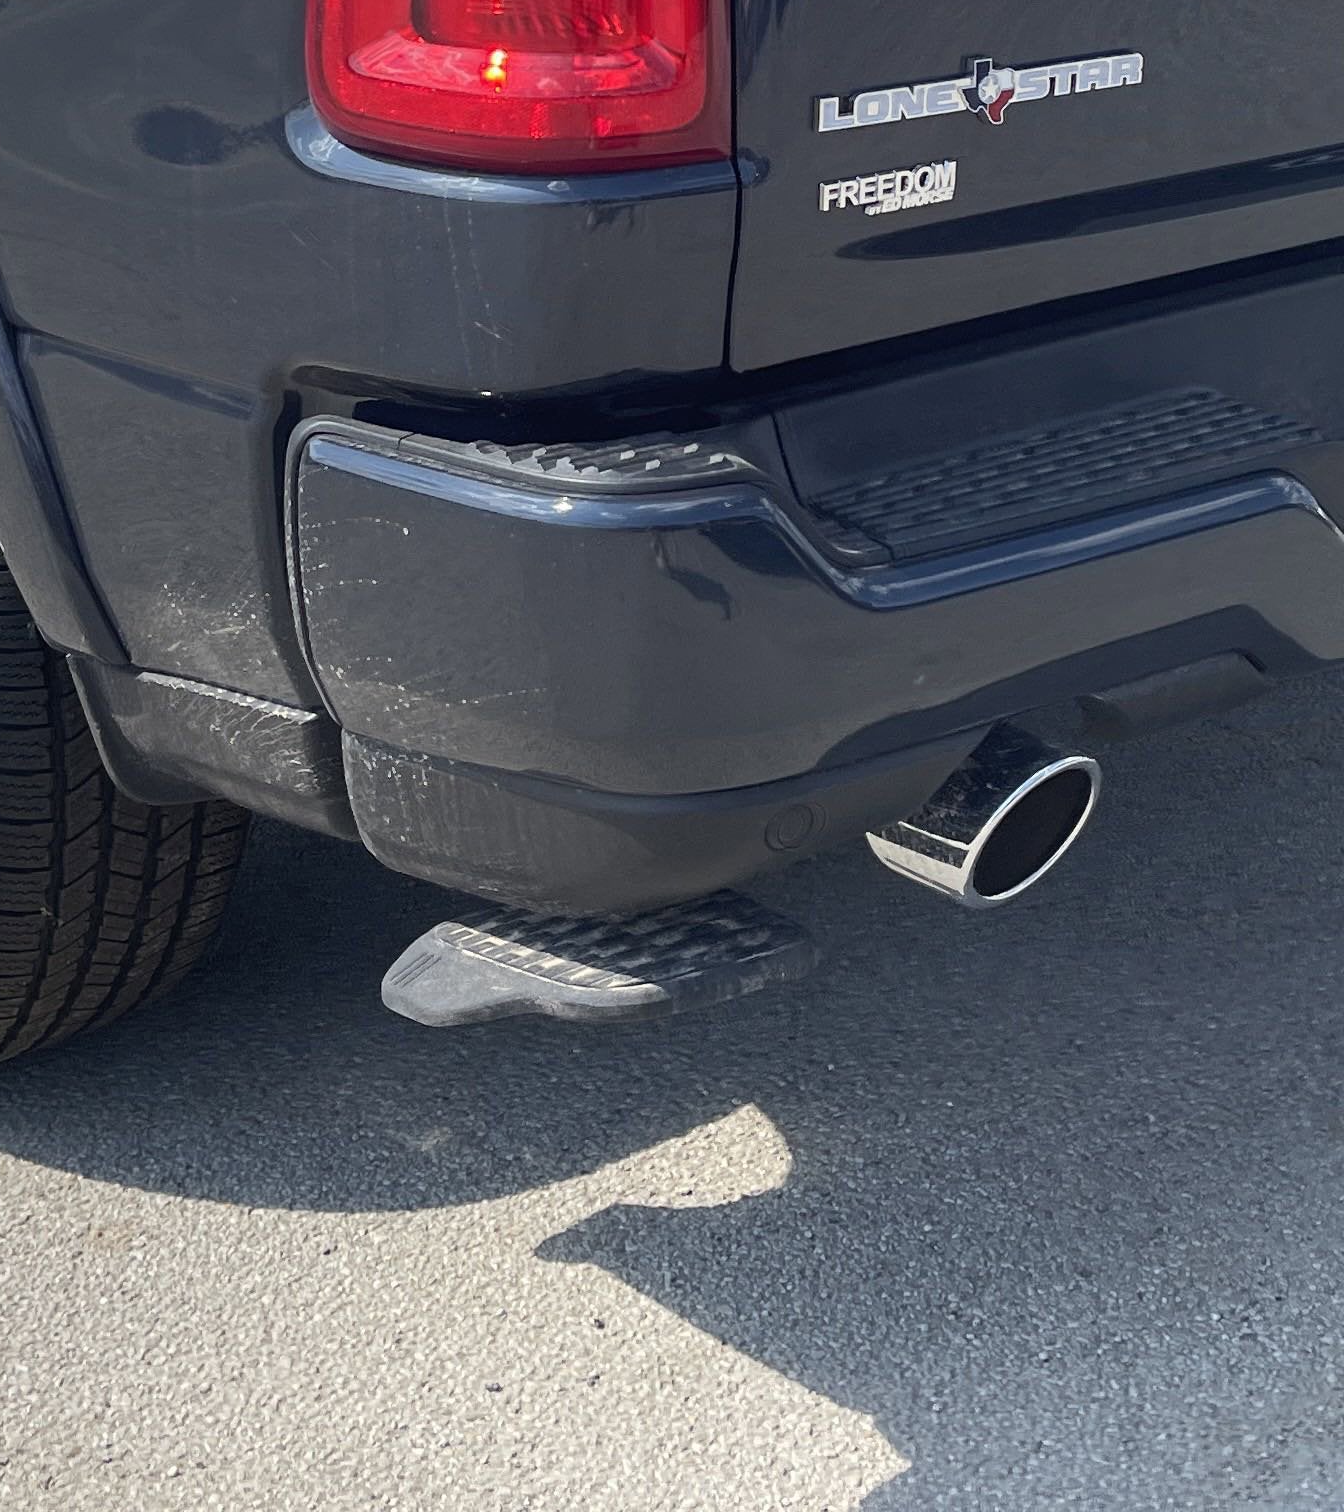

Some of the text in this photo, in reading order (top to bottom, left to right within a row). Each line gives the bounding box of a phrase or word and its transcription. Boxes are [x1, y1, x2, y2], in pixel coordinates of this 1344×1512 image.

[814, 52, 1144, 132] LONE STAR
[820, 160, 958, 212] FREEDOM
[881, 196, 902, 213] ED
[902, 187, 954, 209] MORSE
